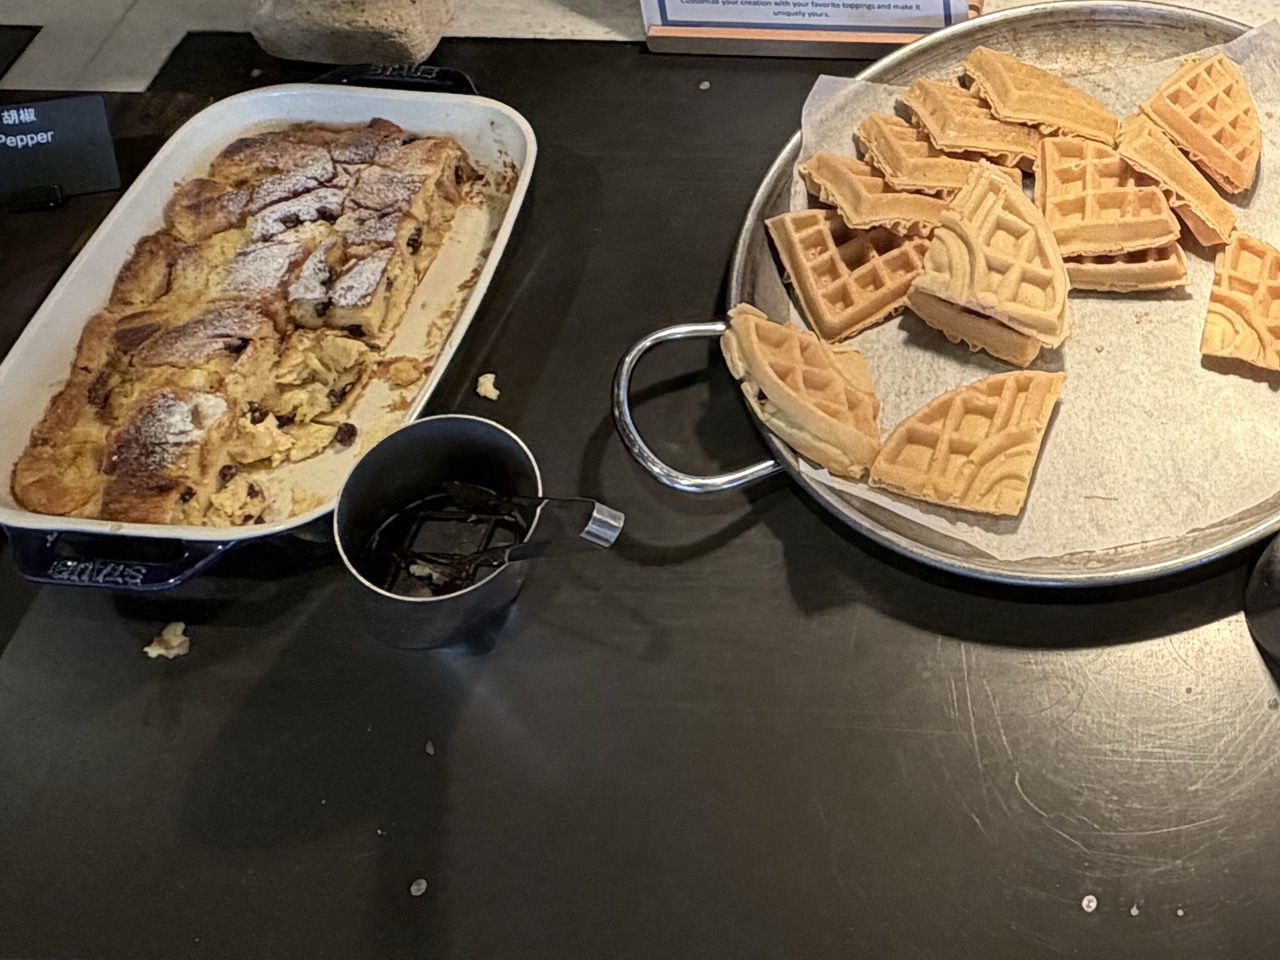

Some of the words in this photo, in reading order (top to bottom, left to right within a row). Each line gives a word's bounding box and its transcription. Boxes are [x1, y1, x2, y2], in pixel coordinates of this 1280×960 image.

[811, 0, 840, 8] favorite
[842, 2, 875, 10] toppings
[893, 3, 913, 11] make
[915, 3, 921, 11] it
[1, 107, 37, 125] 胡椒
